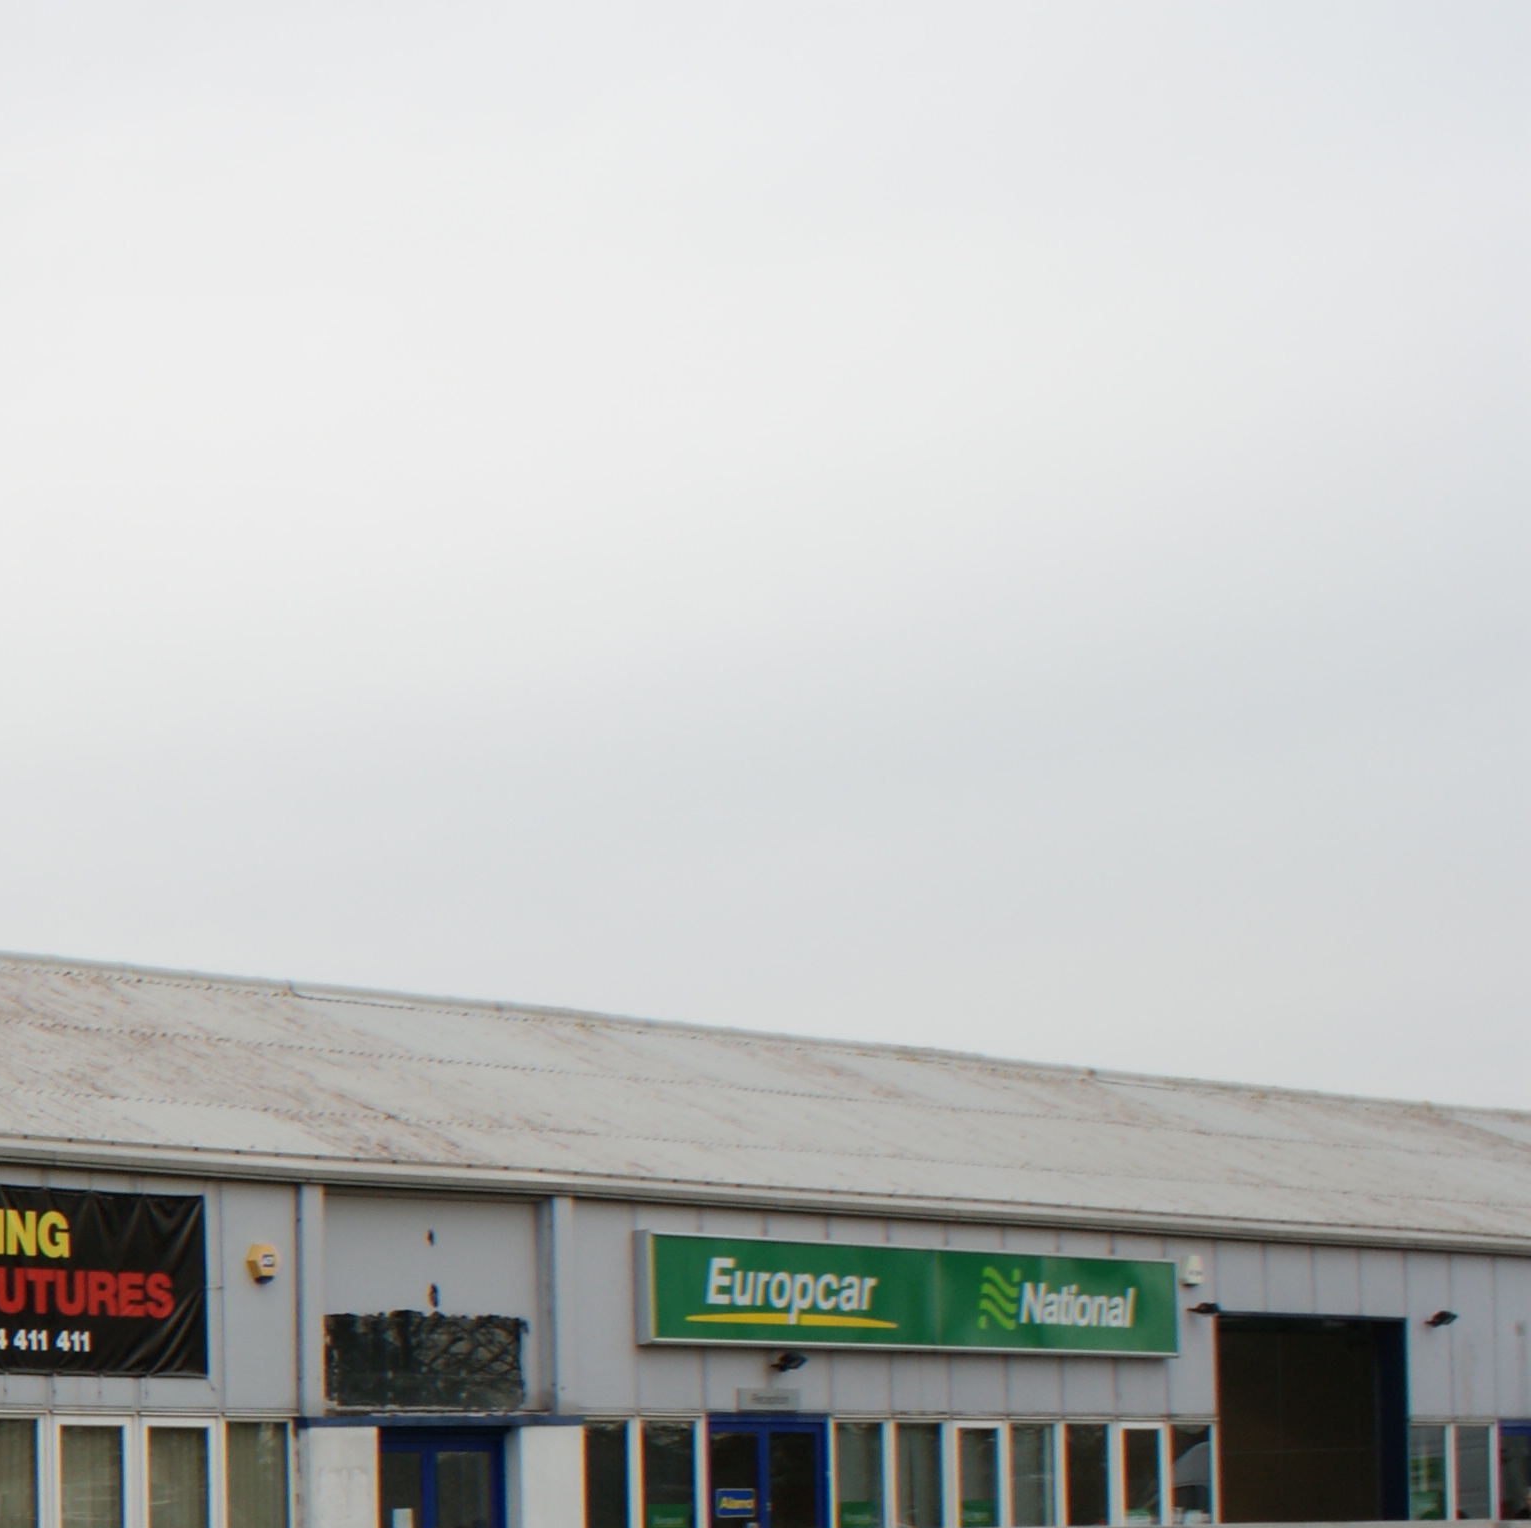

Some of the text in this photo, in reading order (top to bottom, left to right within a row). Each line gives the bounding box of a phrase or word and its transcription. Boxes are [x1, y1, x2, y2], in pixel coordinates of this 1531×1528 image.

[705, 1257, 879, 1325] Europcar
[1019, 1281, 1137, 1328] National
[13, 1329, 48, 1351] 411
[55, 1331, 90, 1352] 411
